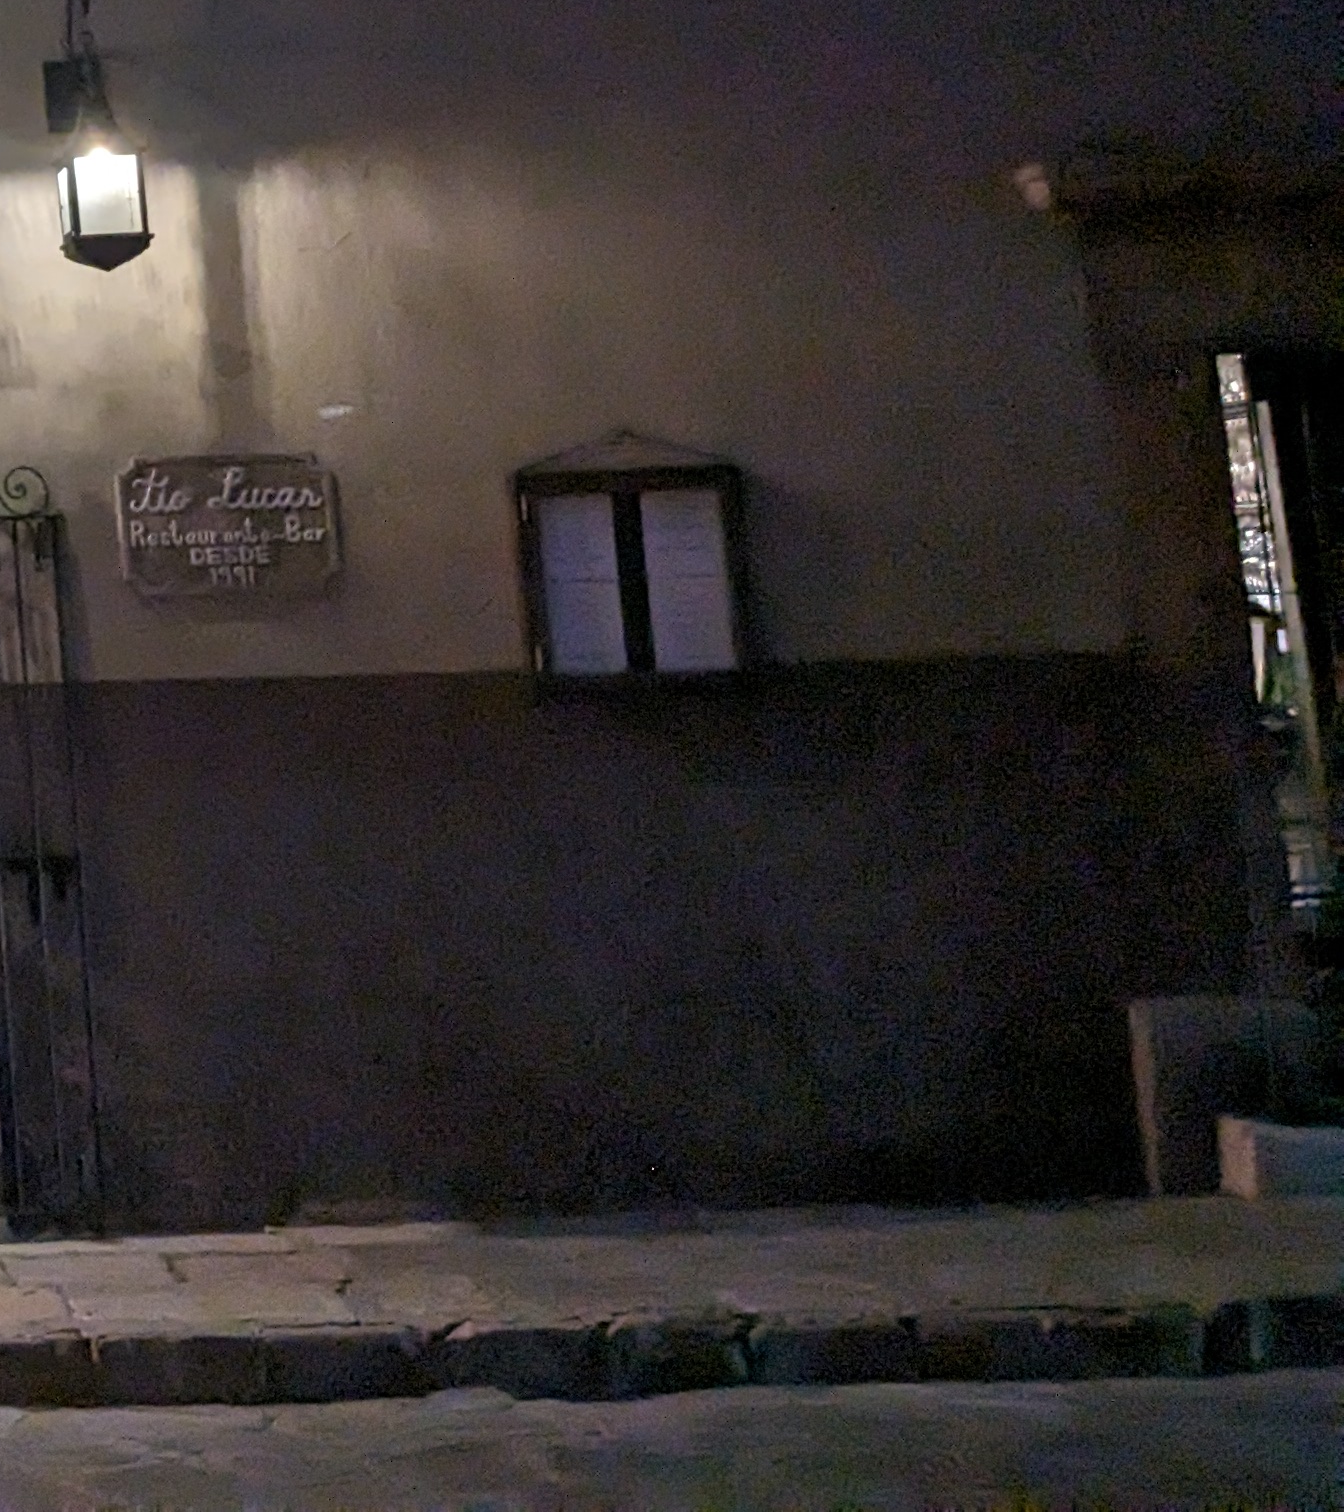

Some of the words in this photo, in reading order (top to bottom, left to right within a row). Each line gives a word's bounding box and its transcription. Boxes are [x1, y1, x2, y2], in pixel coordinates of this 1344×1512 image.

[207, 466, 324, 510] Lucas
[190, 547, 272, 565] DESDE
[210, 566, 256, 587] 1991
